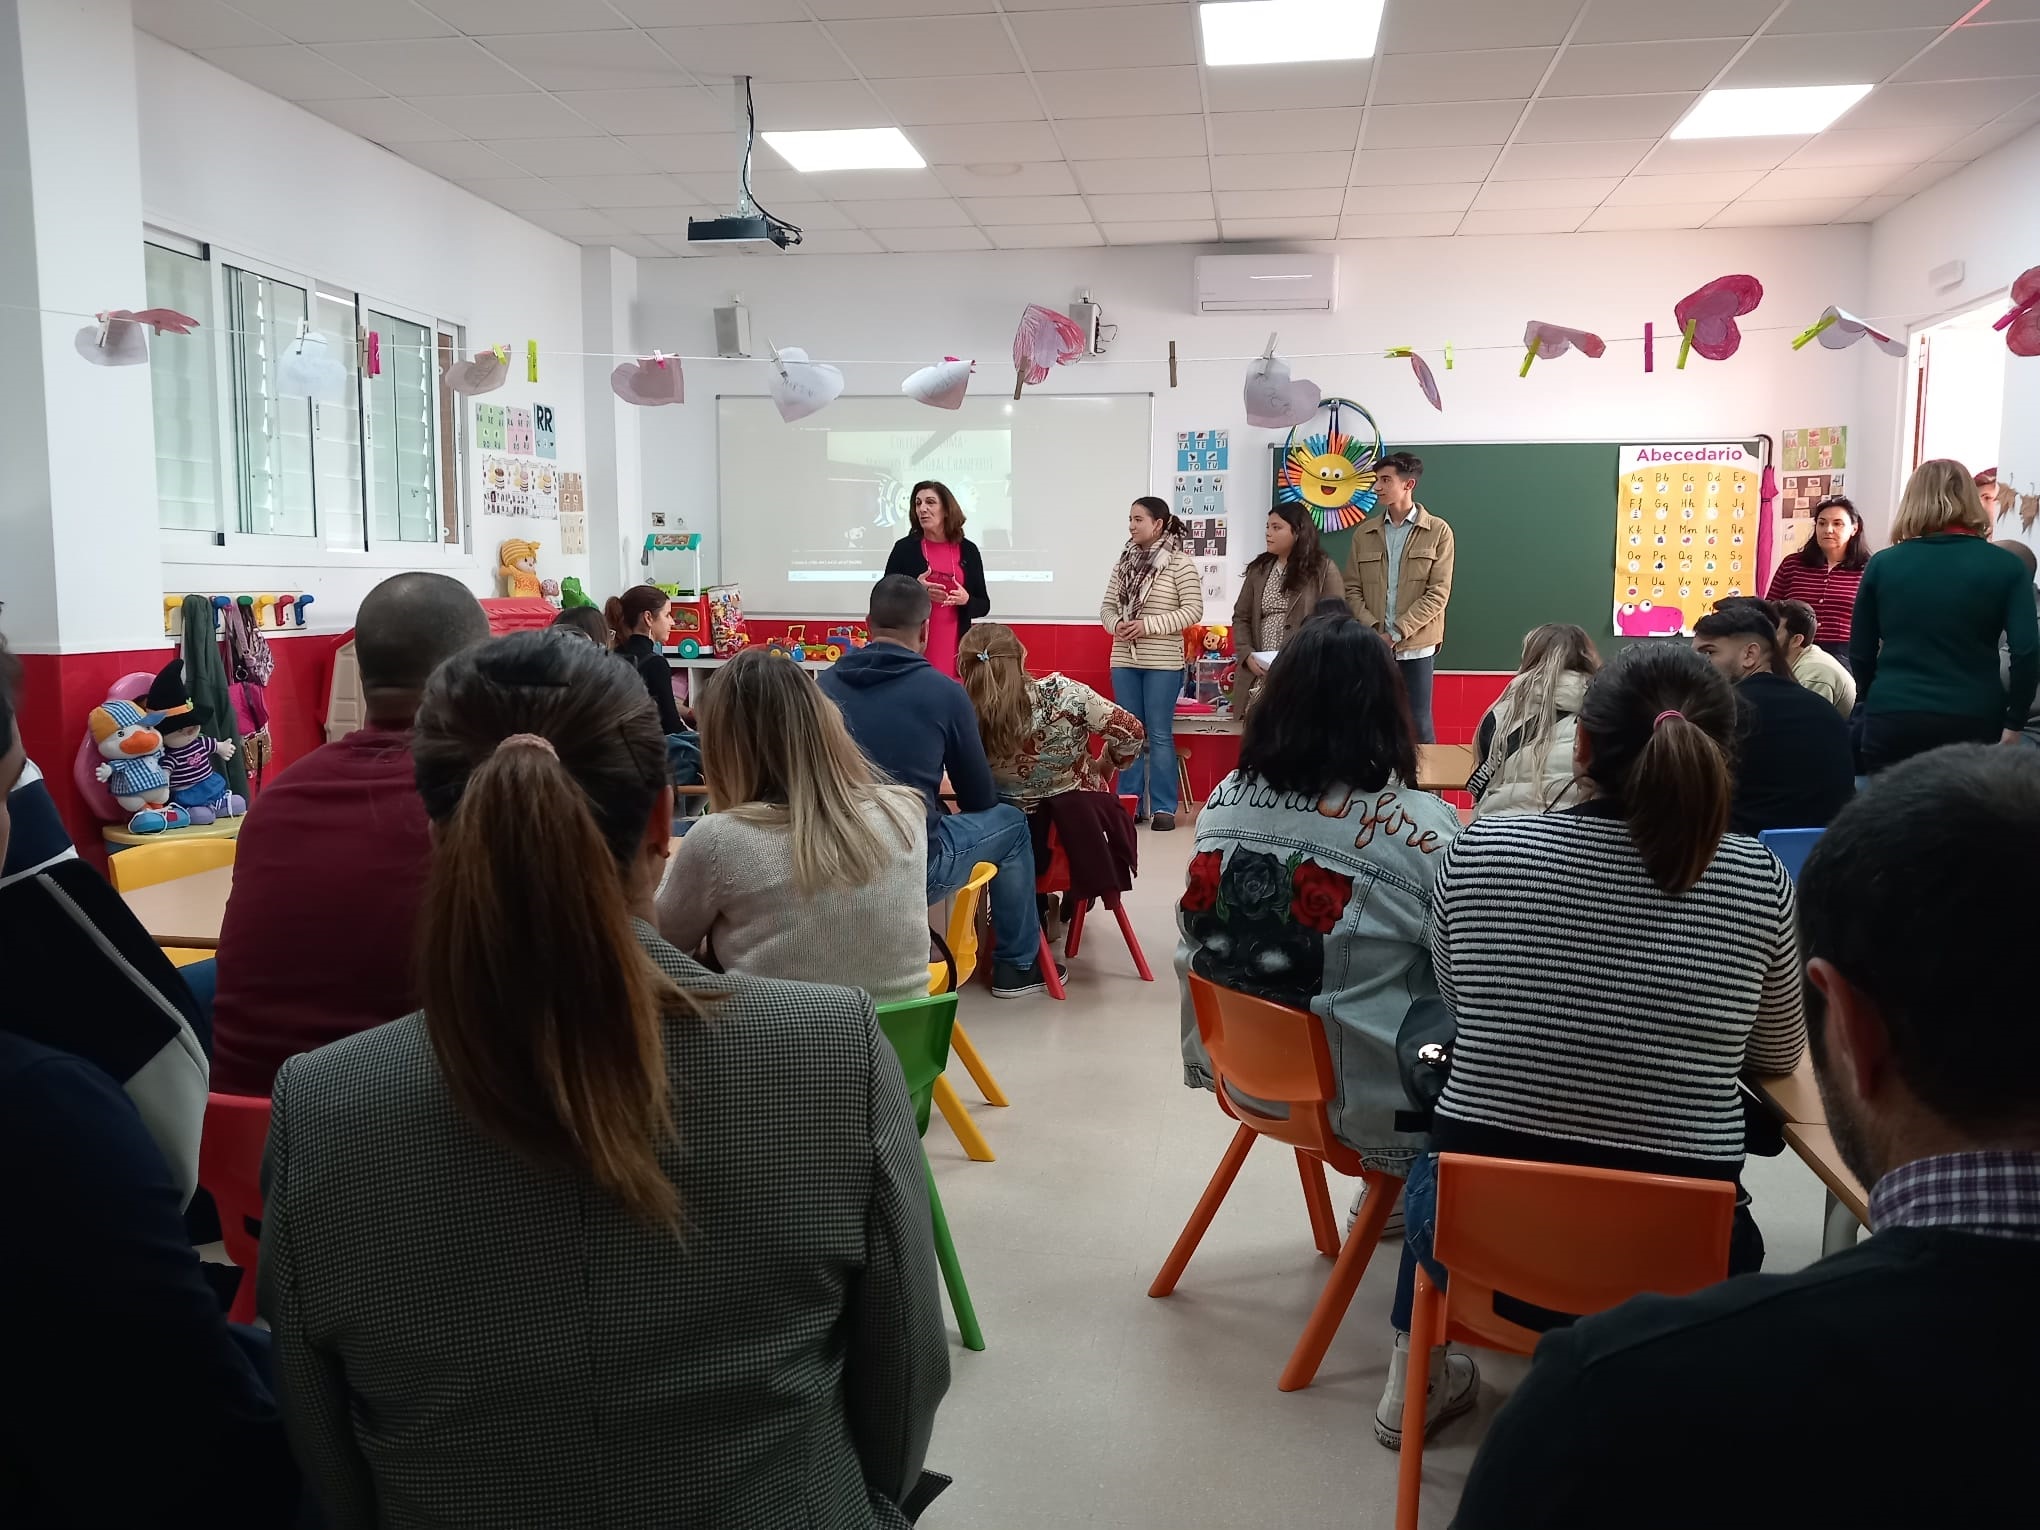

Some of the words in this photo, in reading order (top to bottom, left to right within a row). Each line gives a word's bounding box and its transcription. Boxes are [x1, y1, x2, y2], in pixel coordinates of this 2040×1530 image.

[536, 404, 553, 432] RR
[1179, 442, 1189, 450] TA
[1197, 441, 1206, 449] TE
[1217, 440, 1225, 448] TI
[1636, 447, 1743, 461] Abecedario
[1189, 463, 1200, 471] TO
[1181, 507, 1193, 515] NO
[1203, 504, 1215, 512] NU
[1193, 530, 1204, 538] ME
[1215, 529, 1225, 537] MI
[1205, 548, 1217, 556] MU
